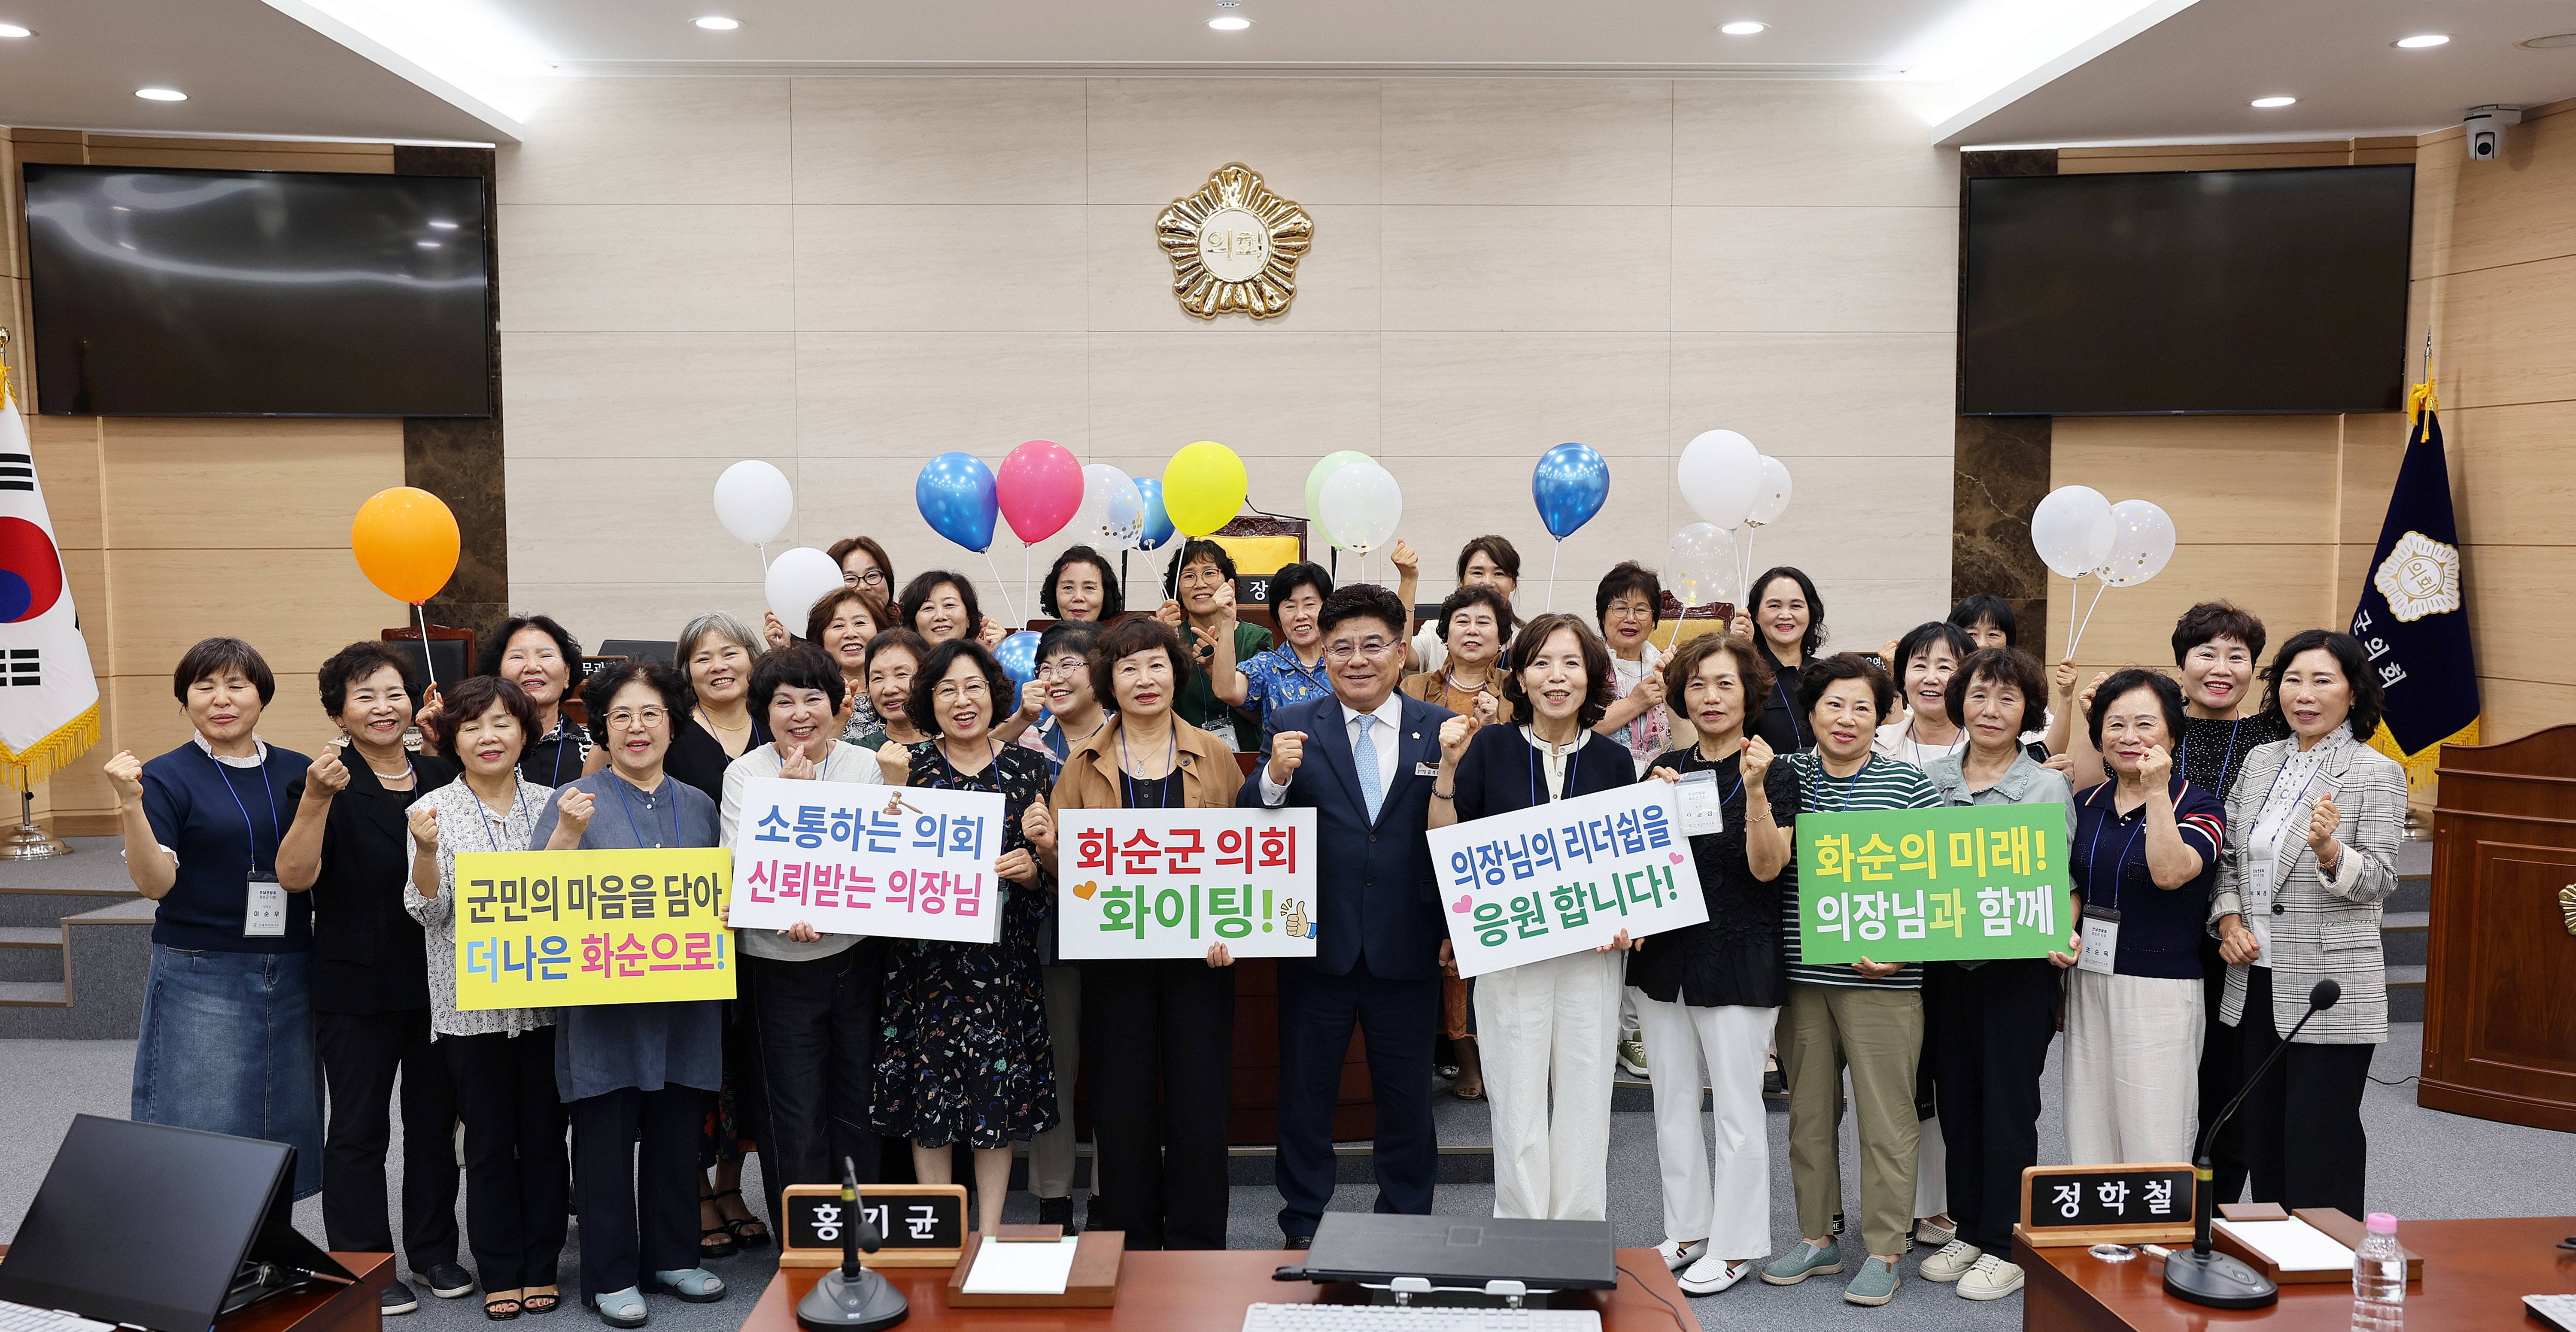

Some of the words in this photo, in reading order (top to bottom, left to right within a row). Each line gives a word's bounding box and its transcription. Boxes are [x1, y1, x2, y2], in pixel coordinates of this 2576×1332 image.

[1206, 228, 1262, 262] 의회
[2407, 562, 2437, 594] 의회
[755, 805, 901, 853] 소통하는
[912, 813, 984, 860] 의회
[1077, 827, 1205, 875] 화순군
[1215, 826, 1296, 874] 의회
[1451, 828, 1561, 889] 의장님의
[1562, 804, 1671, 864] 리더쉽을
[1815, 830, 1936, 882] 화순의
[1949, 825, 2047, 877] 미래!
[468, 876, 558, 923] 군민의
[568, 874, 656, 920] 마음을
[664, 873, 722, 917] 담아
[747, 860, 875, 909] 신뢰받는
[885, 868, 981, 916] 의장님
[1099, 884, 1273, 940] 화이팅!
[1473, 891, 1549, 947] 응원
[1549, 864, 1677, 929] 합니다!
[1816, 888, 1966, 941] 의장님과
[1977, 885, 2054, 936] 함께
[581, 933, 724, 978] 화순으로!
[2052, 1180, 2172, 1218] 정학철
